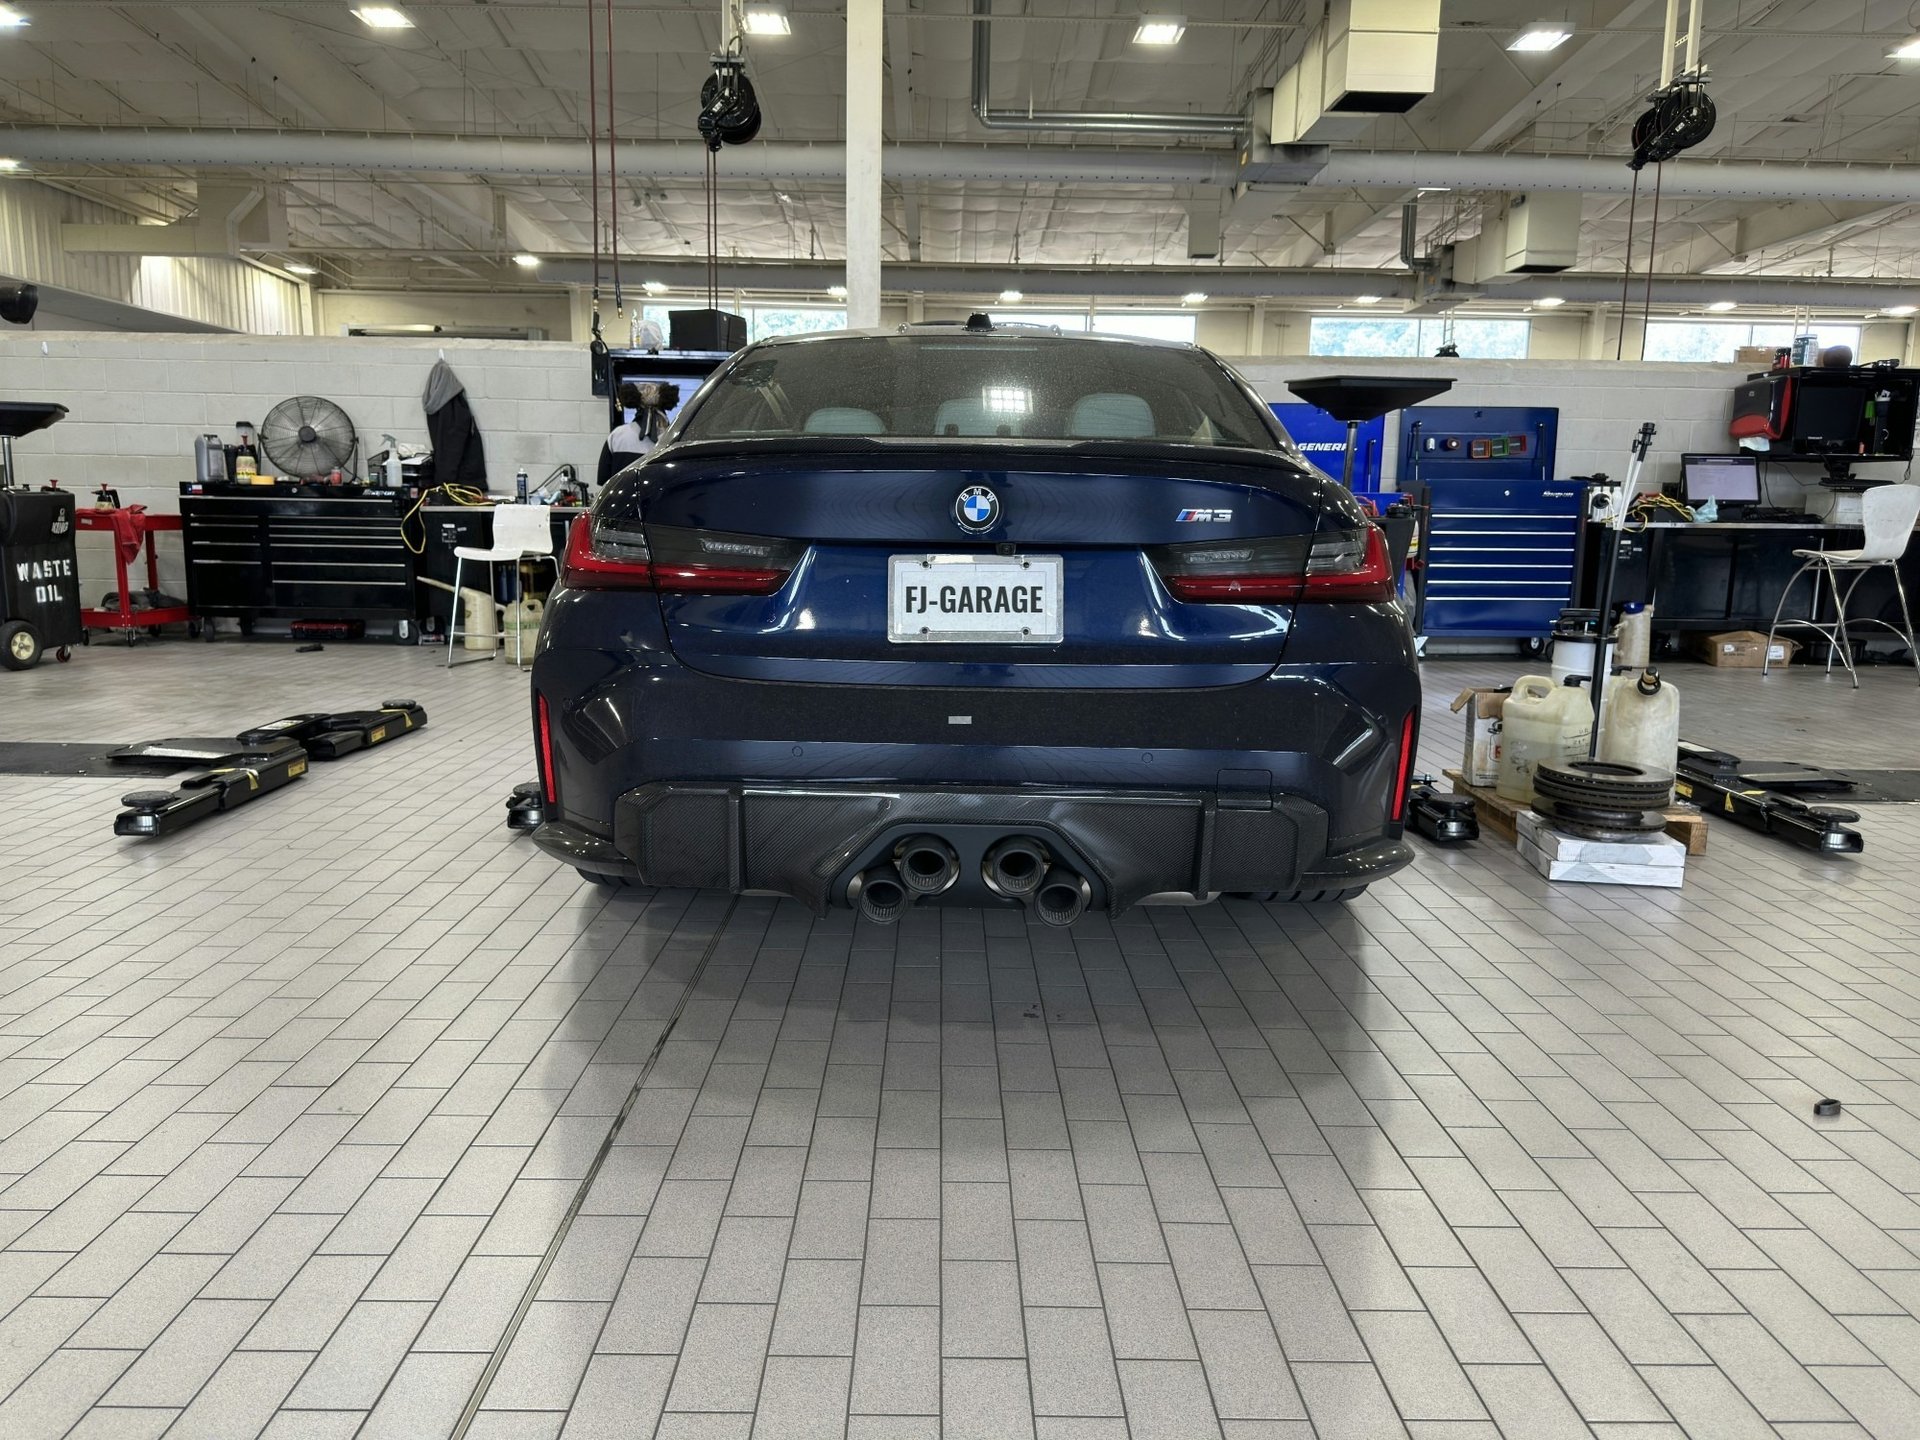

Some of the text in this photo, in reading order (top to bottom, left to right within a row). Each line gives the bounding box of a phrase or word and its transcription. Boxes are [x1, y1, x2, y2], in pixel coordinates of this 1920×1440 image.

[1298, 442, 1357, 451] GENERA
[961, 488, 995, 502] BMW
[1190, 508, 1233, 522] M3
[16, 559, 72, 582] WASTE
[35, 584, 63, 603] OIL
[905, 585, 1043, 614] FJ-GARAGE
